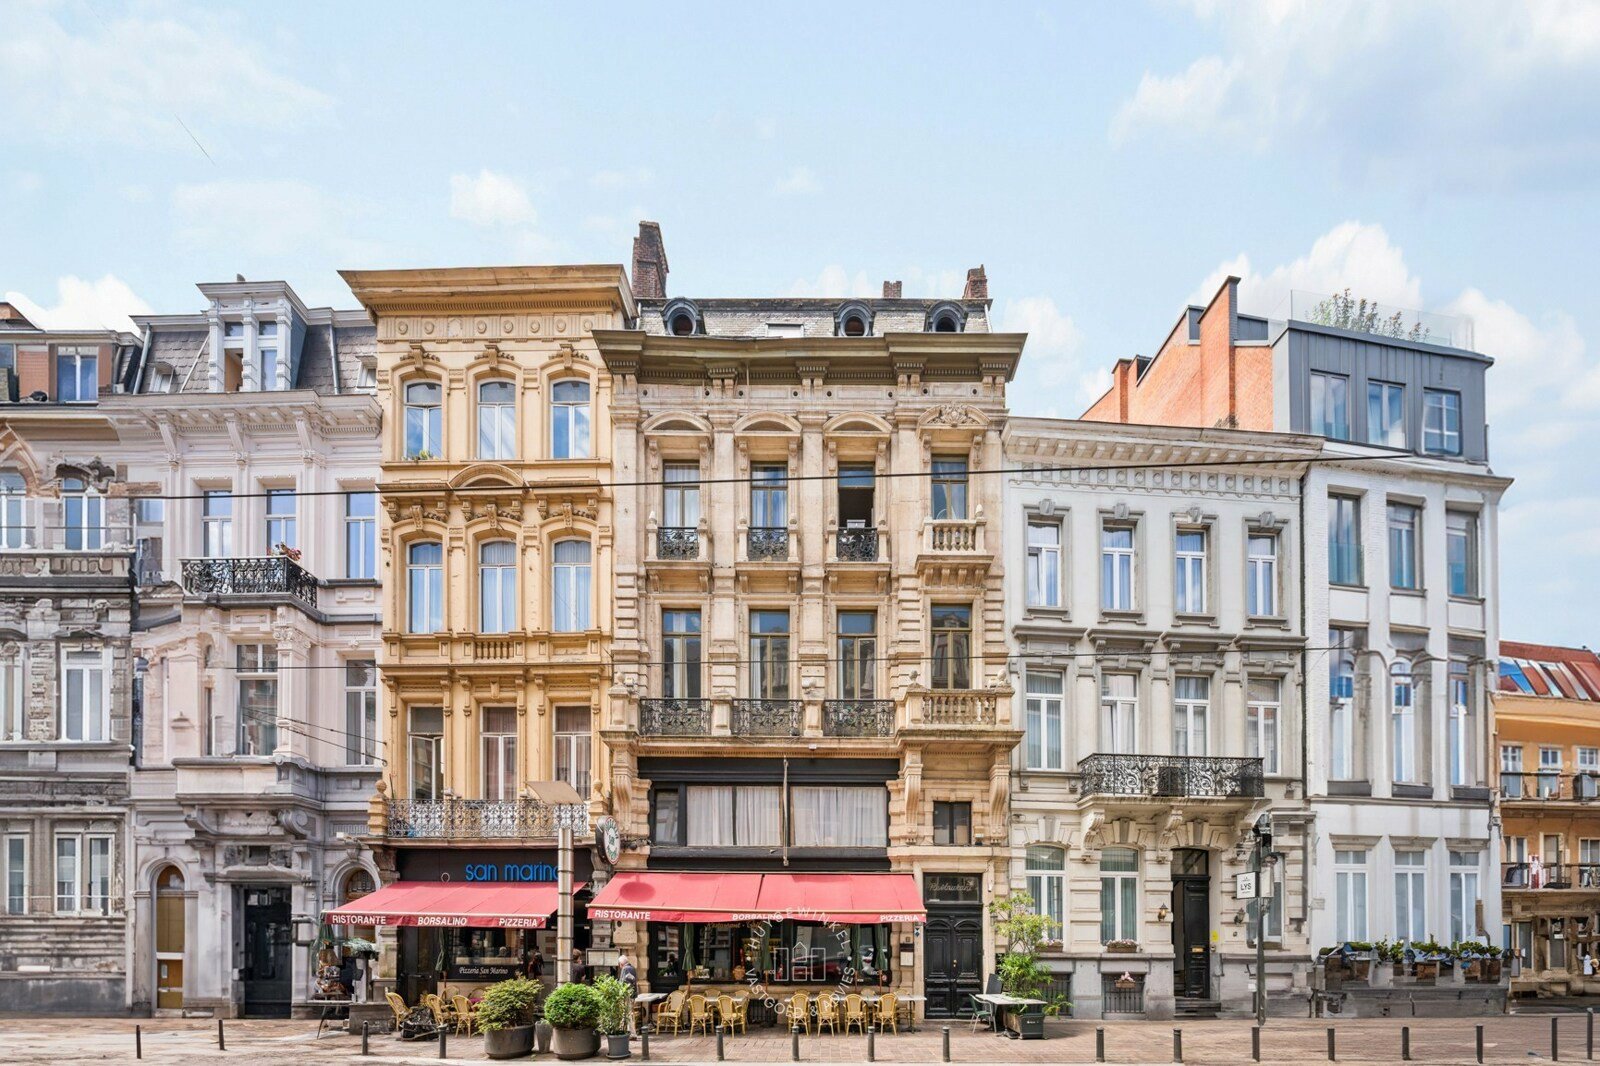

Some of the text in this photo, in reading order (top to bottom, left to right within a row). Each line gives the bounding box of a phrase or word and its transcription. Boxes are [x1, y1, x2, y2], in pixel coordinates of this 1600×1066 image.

[465, 863, 498, 881] san
[1240, 882, 1252, 891] LYS
[332, 914, 386, 925] RISTORANTE
[594, 910, 651, 920] RISTORANTE
[880, 914, 919, 922] PIZZERIA
[417, 916, 467, 927] BORSALINO
[498, 918, 539, 928] PIZZERIA
[458, 966, 509, 975] Pizzeria San Marino
